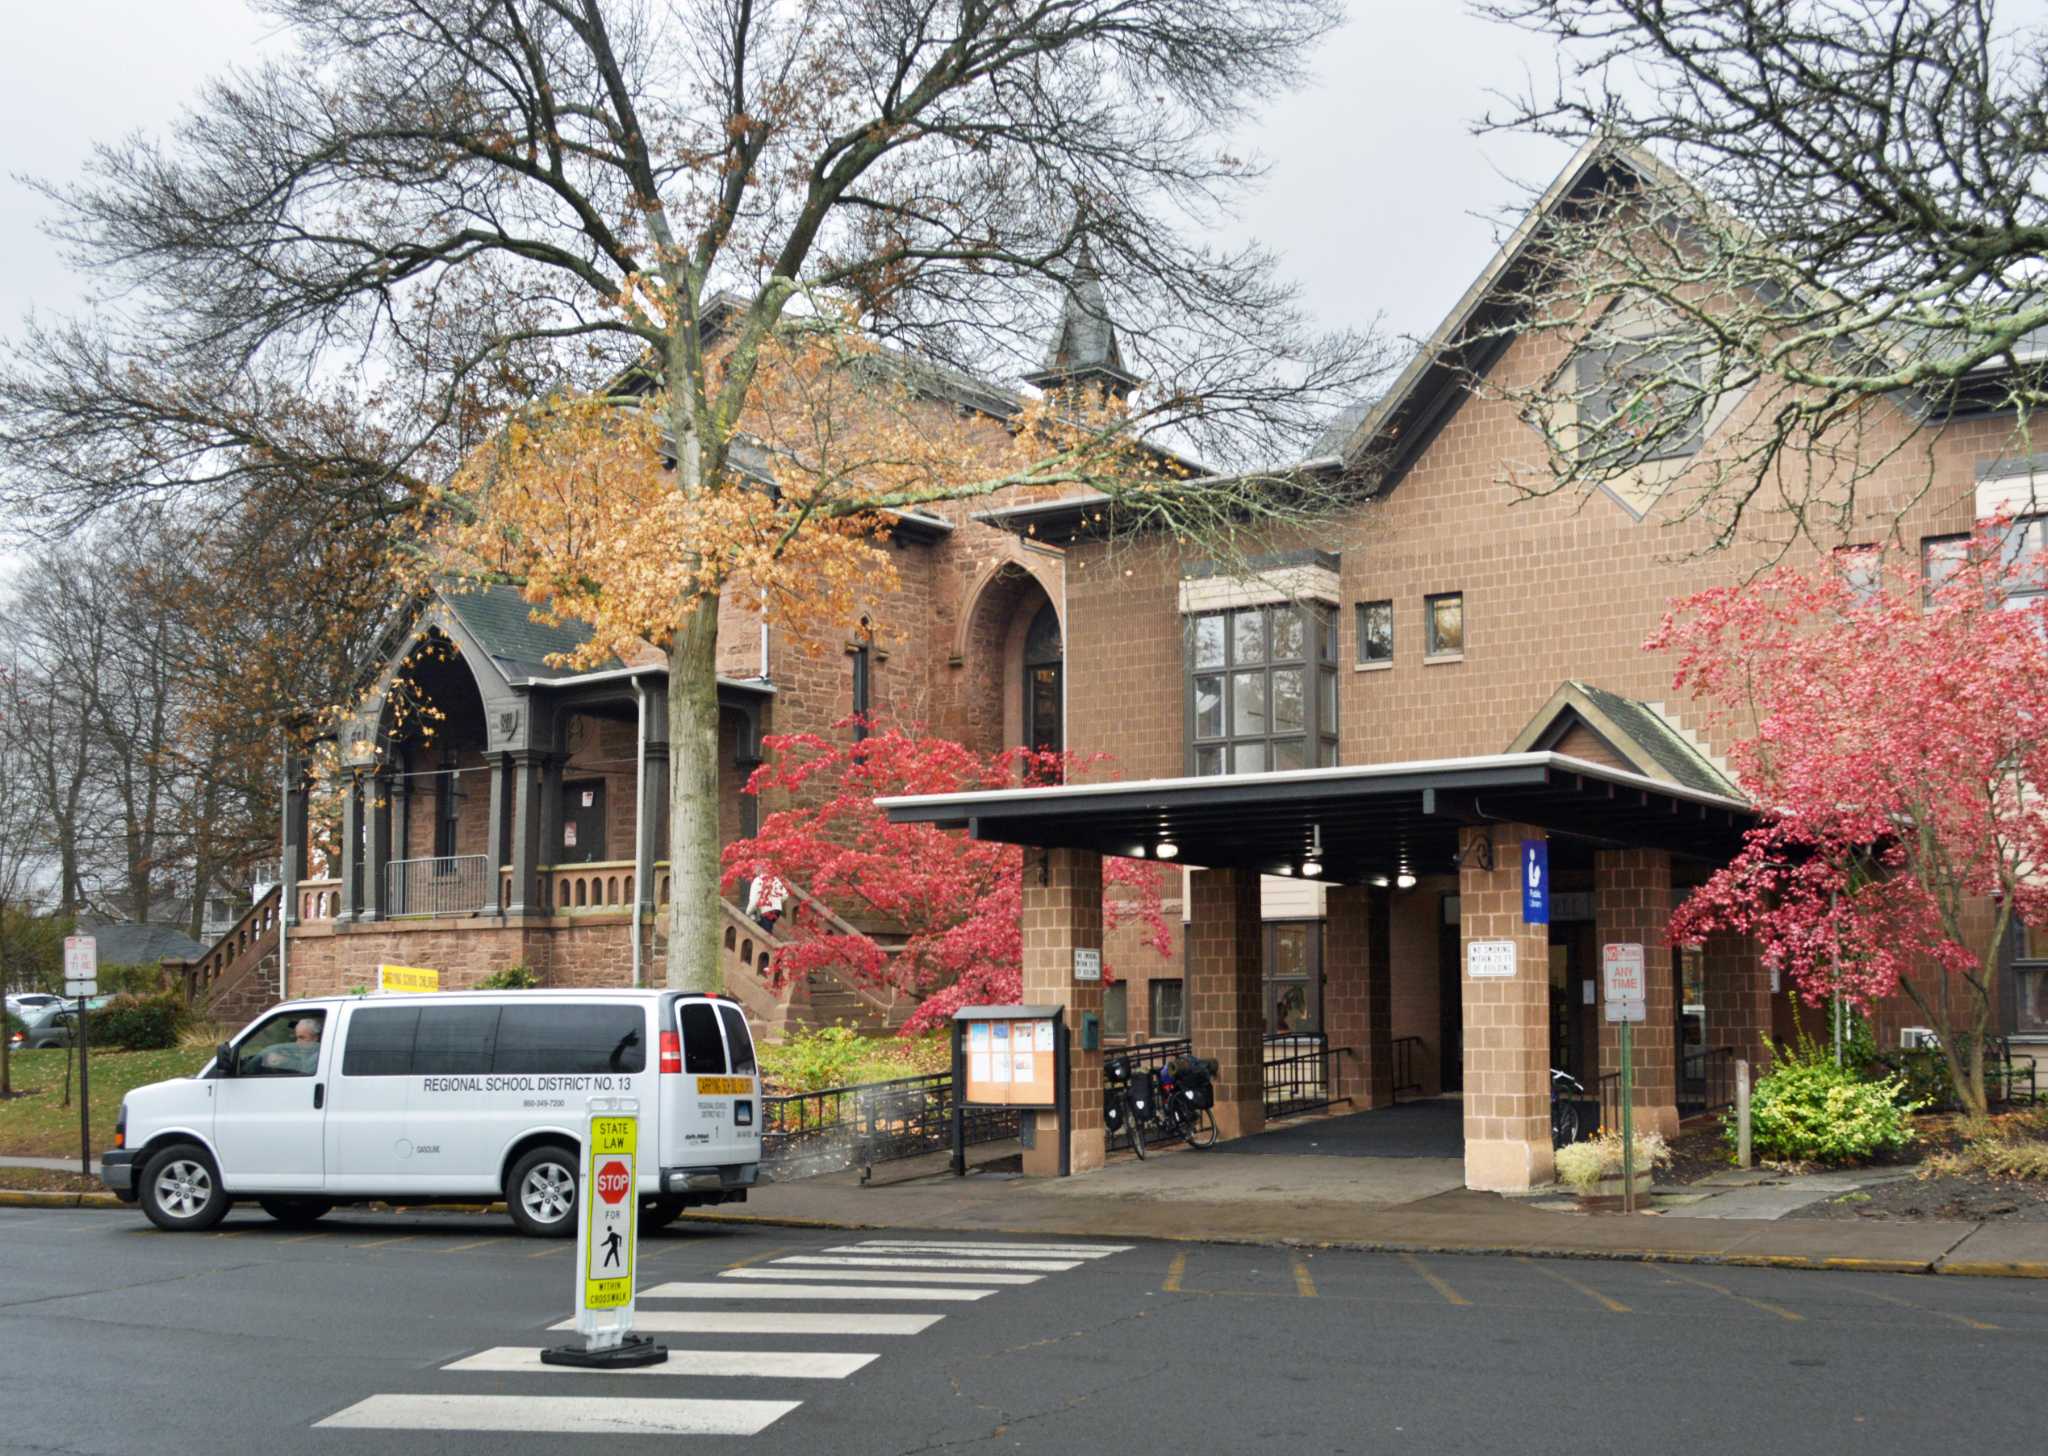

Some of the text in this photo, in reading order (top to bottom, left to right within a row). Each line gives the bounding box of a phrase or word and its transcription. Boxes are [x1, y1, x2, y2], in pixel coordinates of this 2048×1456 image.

[1615, 967, 1633, 976] ANY
[1611, 978, 1638, 988] TIME
[424, 1077, 631, 1092] REGIONAL SCHOOL DISTRICT NO. 13
[600, 1123, 629, 1135] STATE
[604, 1137, 625, 1149] LAW
[599, 1174, 628, 1191] STOP
[605, 1210, 620, 1219] FOR
[598, 1281, 621, 1291] WITHIN
[590, 1293, 627, 1304] CROSSWALK
